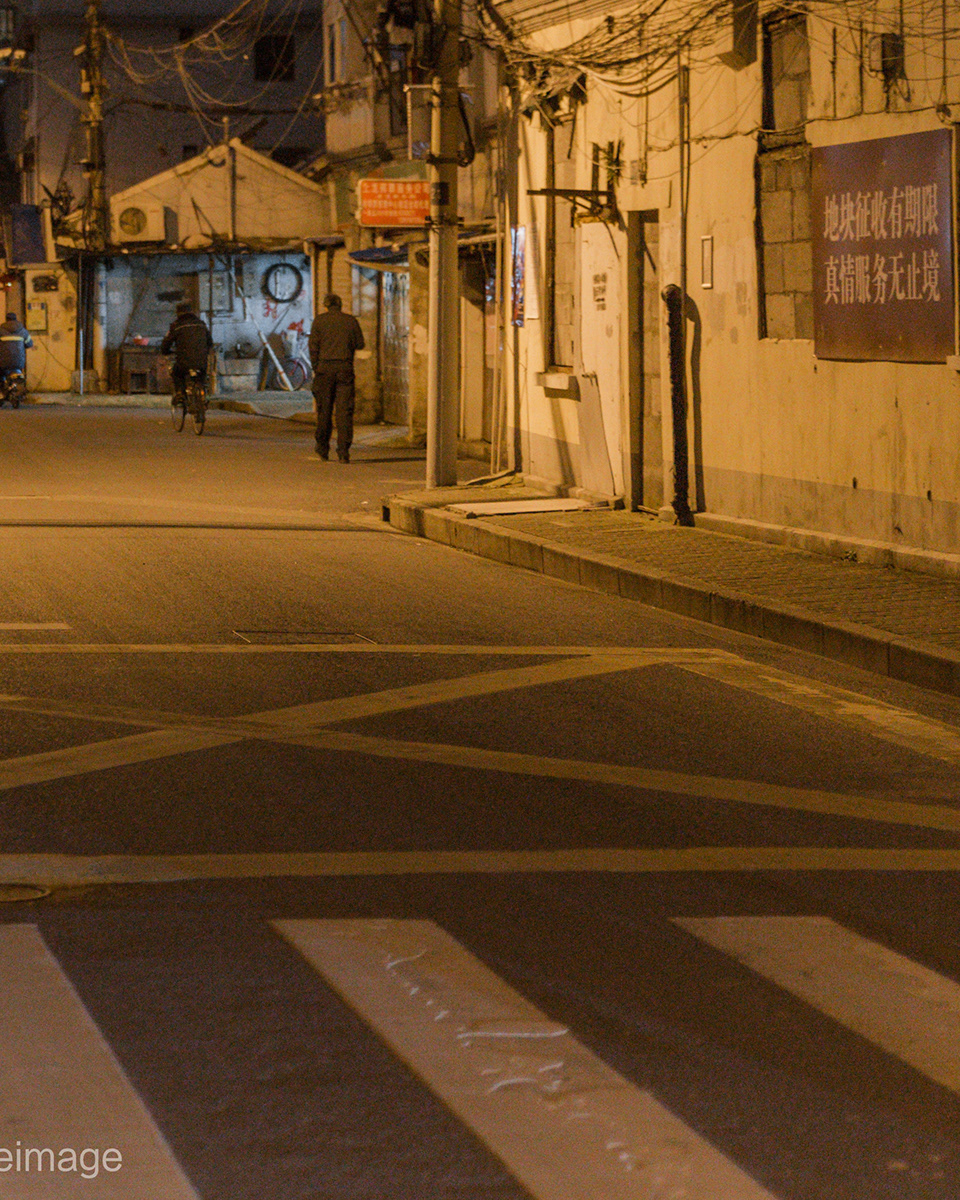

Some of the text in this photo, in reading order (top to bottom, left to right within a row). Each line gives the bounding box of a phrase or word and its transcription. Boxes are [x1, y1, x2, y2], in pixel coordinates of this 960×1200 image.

[823, 183, 939, 241] 地块征收有期限
[823, 249, 940, 304] 真情服务无止境
